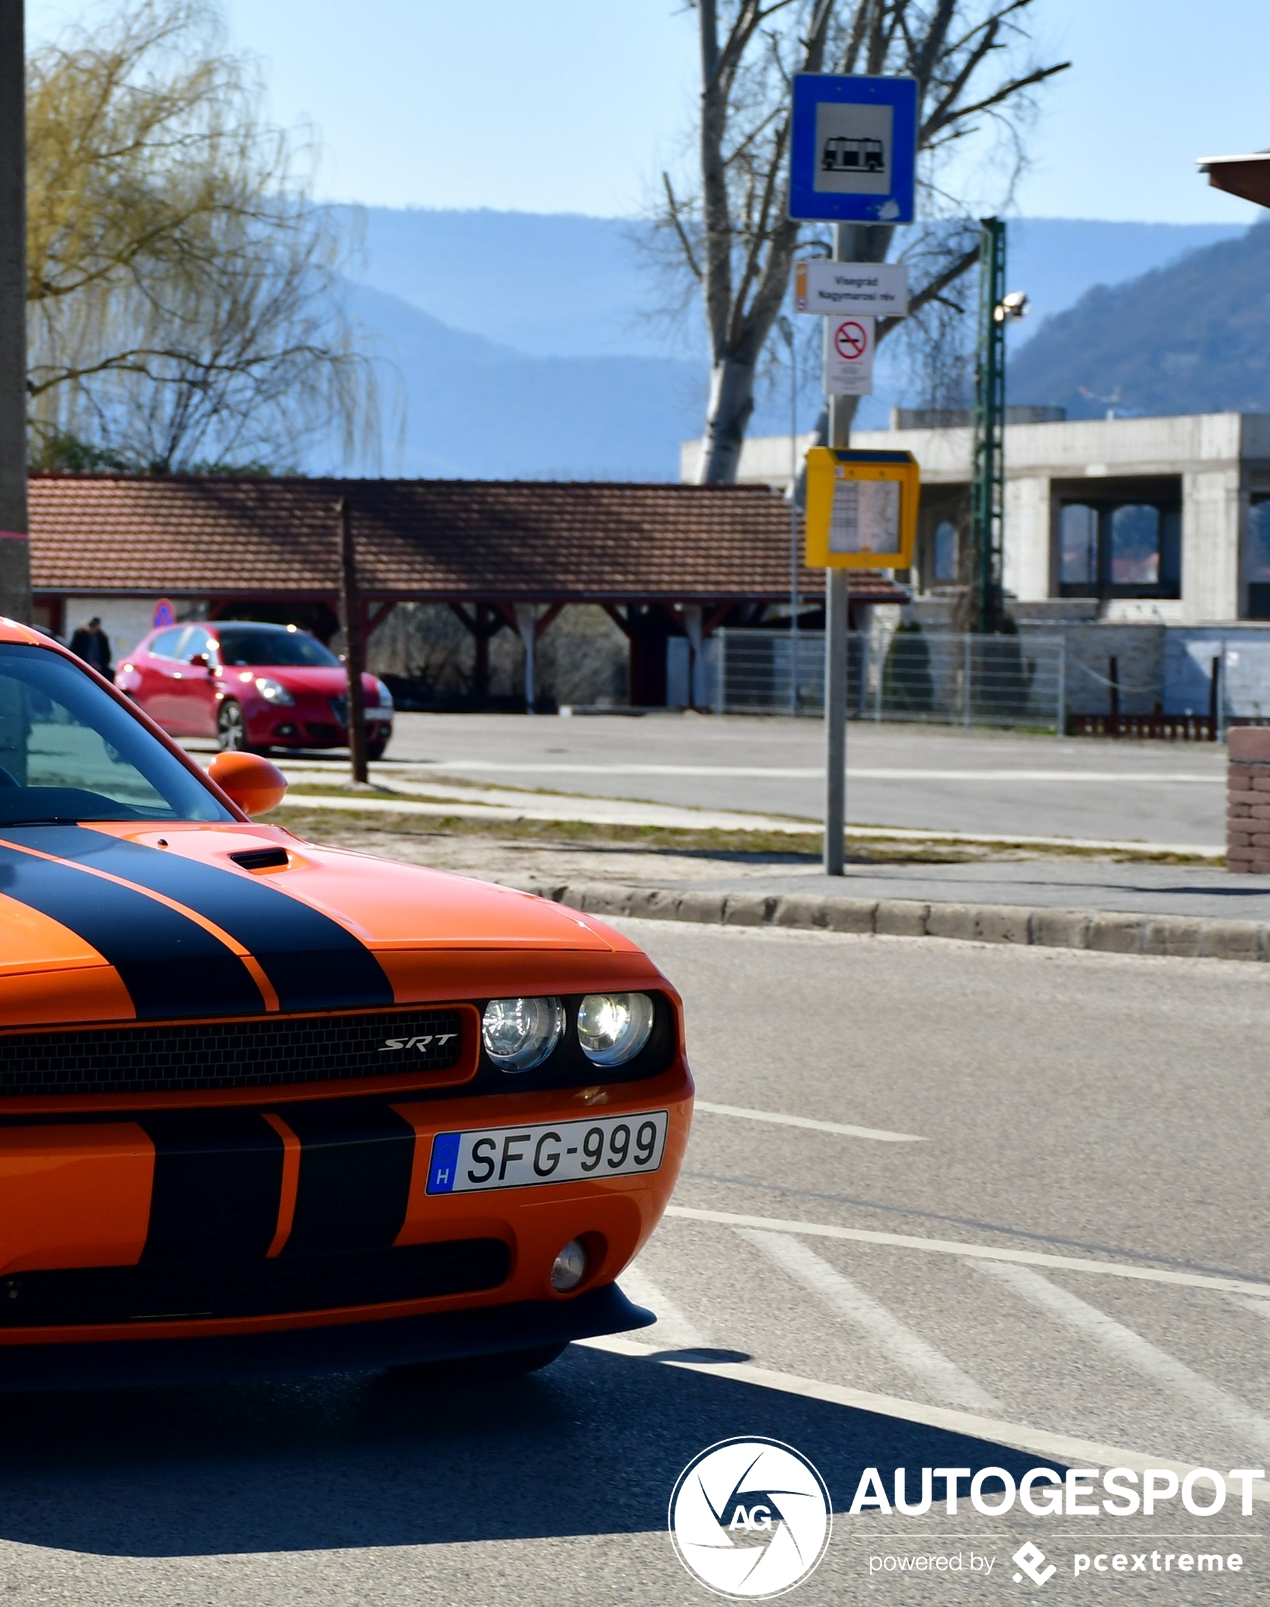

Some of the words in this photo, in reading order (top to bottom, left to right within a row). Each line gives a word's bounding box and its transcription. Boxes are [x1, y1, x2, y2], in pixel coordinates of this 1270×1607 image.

[377, 1033, 459, 1053] SRT
[467, 1120, 657, 1184] SFG-999
[436, 1168, 450, 1185] H
